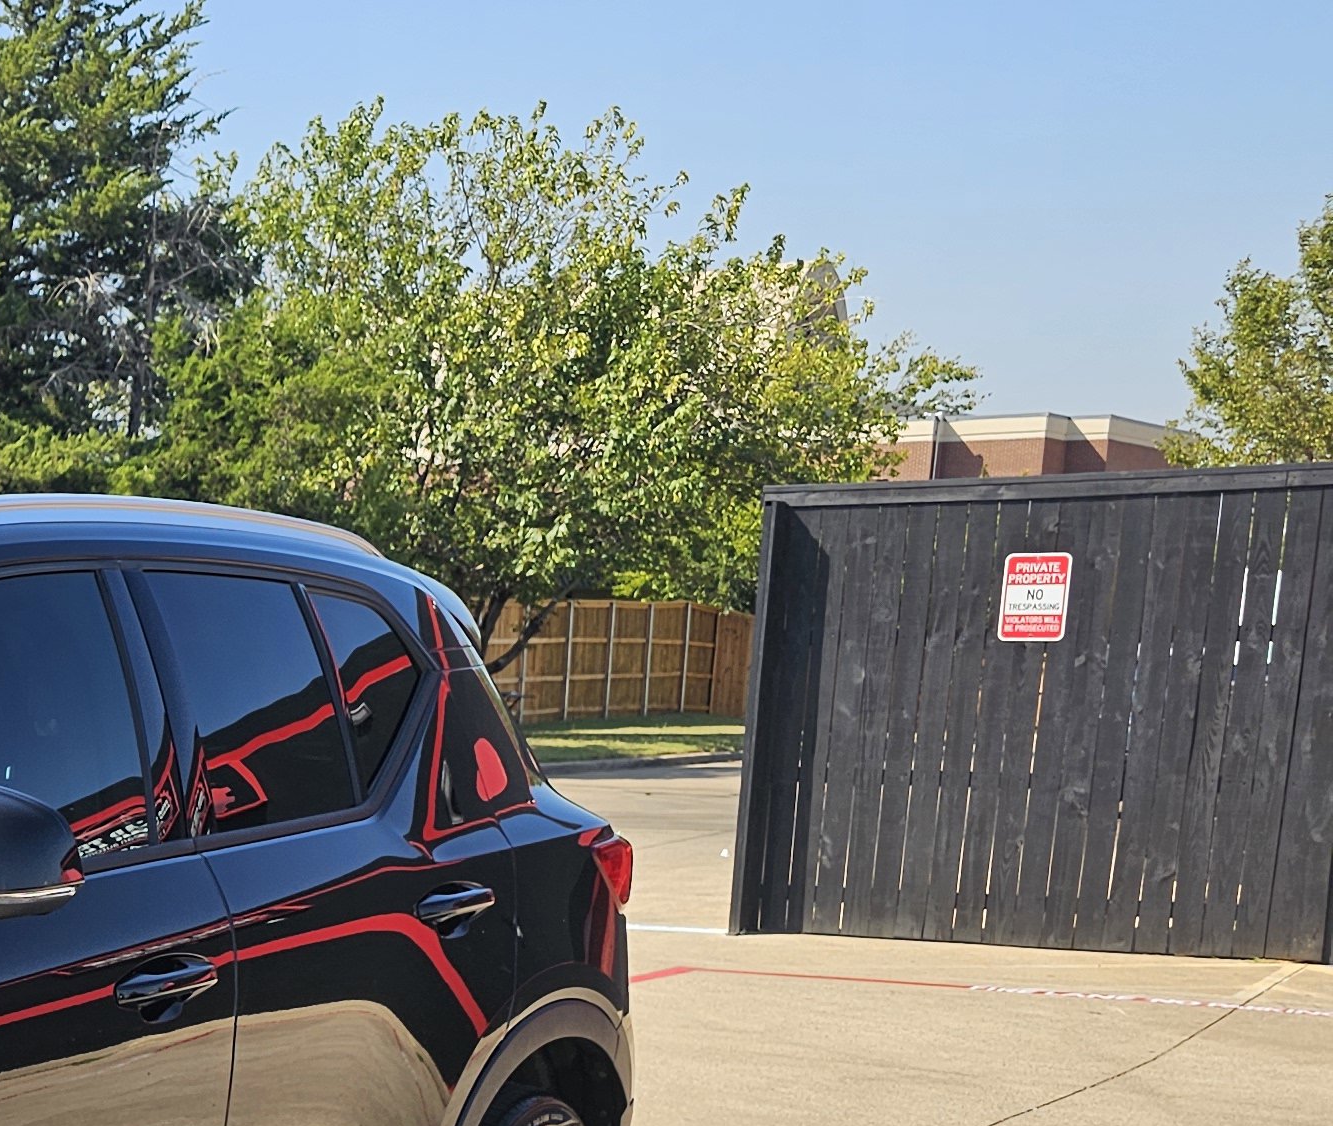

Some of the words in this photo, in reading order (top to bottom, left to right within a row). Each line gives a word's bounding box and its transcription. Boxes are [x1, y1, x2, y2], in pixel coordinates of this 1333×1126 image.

[1015, 562, 1061, 573] PRIVATE
[1007, 573, 1066, 585] PROPERTY
[1027, 589, 1044, 600] NO
[1009, 603, 1060, 611] TRESPASSING
[1005, 616, 1043, 624] VIOLATORS
[1044, 616, 1060, 624] WILL
[1003, 624, 1013, 632] BE
[1015, 624, 1060, 632] PROSECUTED
